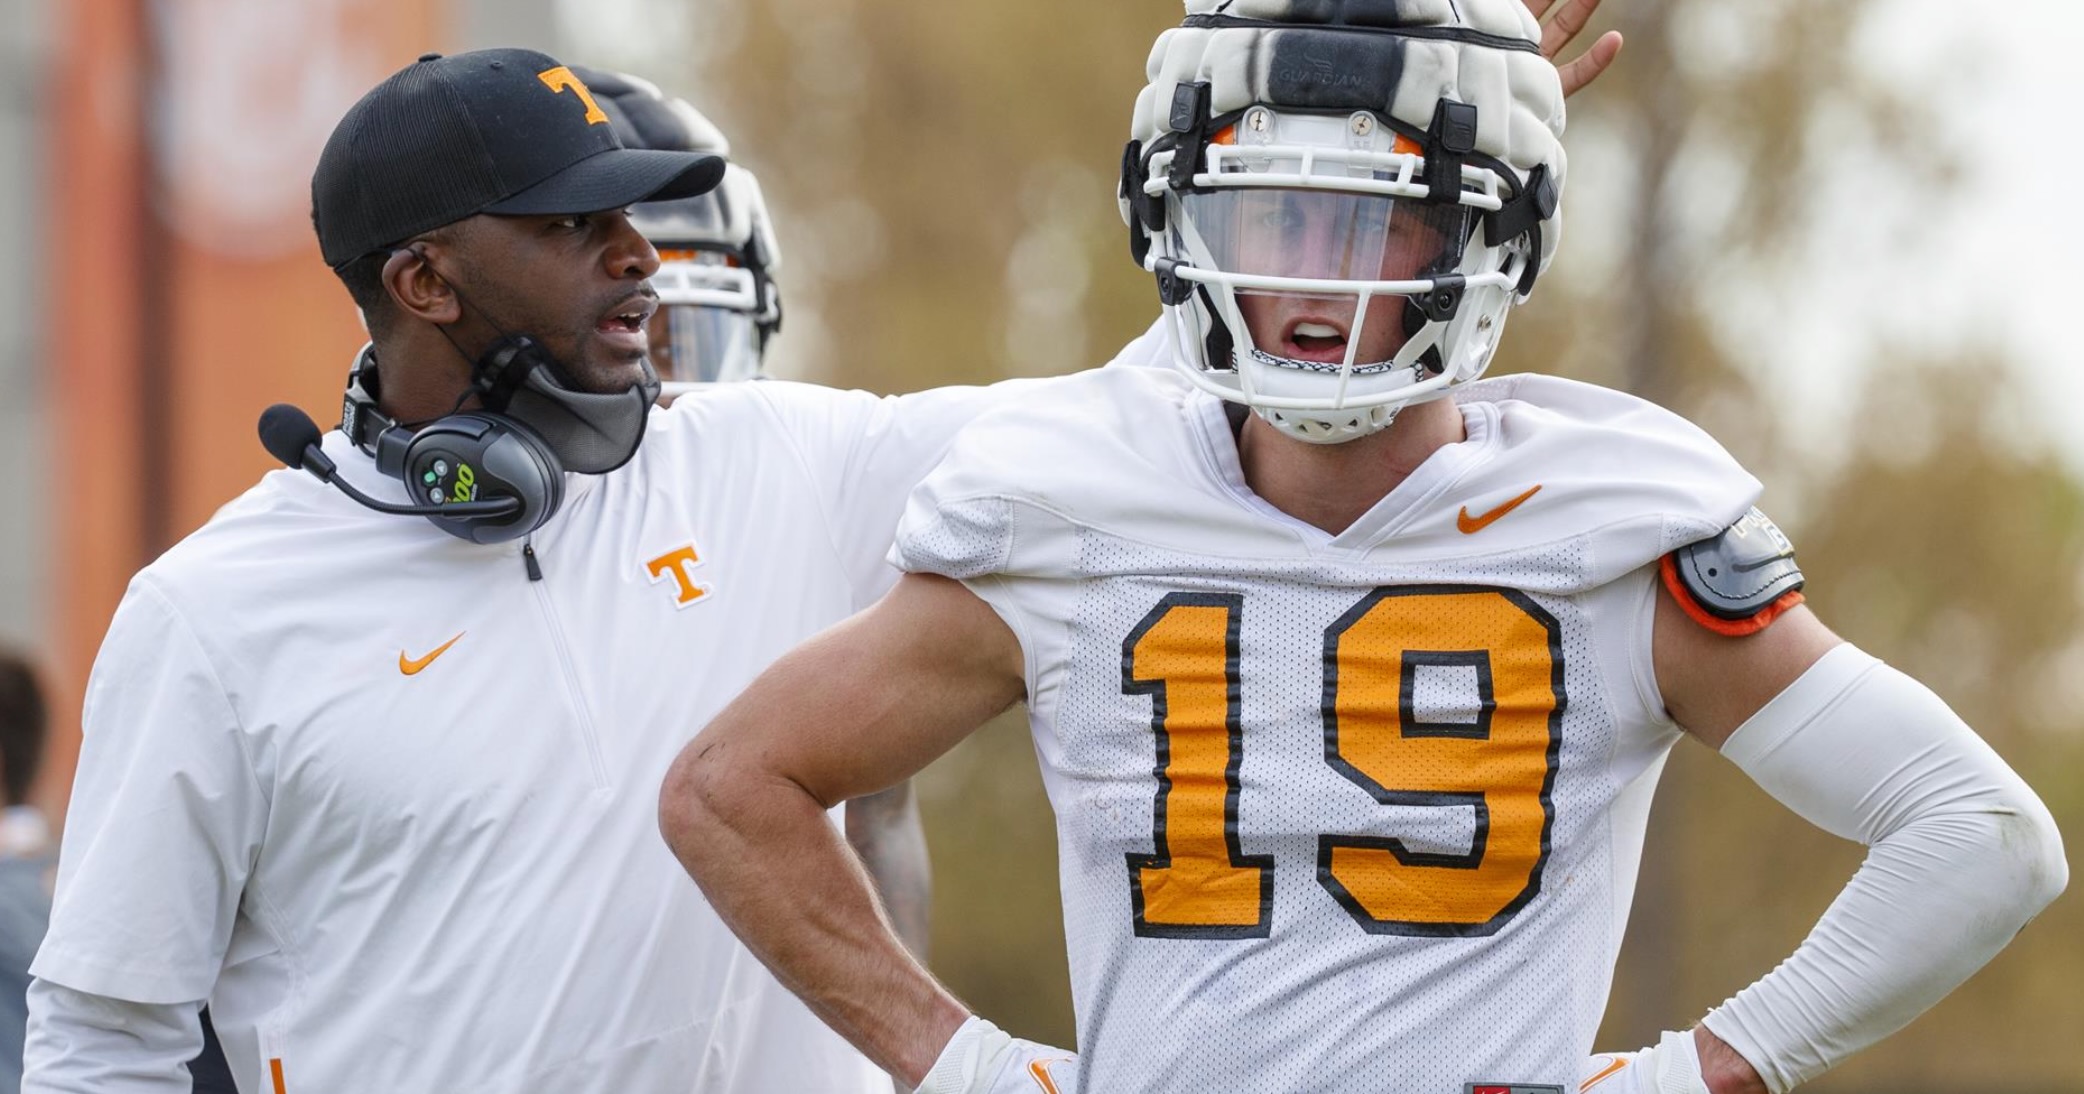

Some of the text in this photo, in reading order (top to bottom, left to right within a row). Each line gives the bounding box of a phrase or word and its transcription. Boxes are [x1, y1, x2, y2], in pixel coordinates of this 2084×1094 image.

[537, 66, 608, 125] T
[1280, 69, 1362, 86] GUARDIAN
[643, 542, 707, 607] T
[1122, 584, 1567, 938] 19
